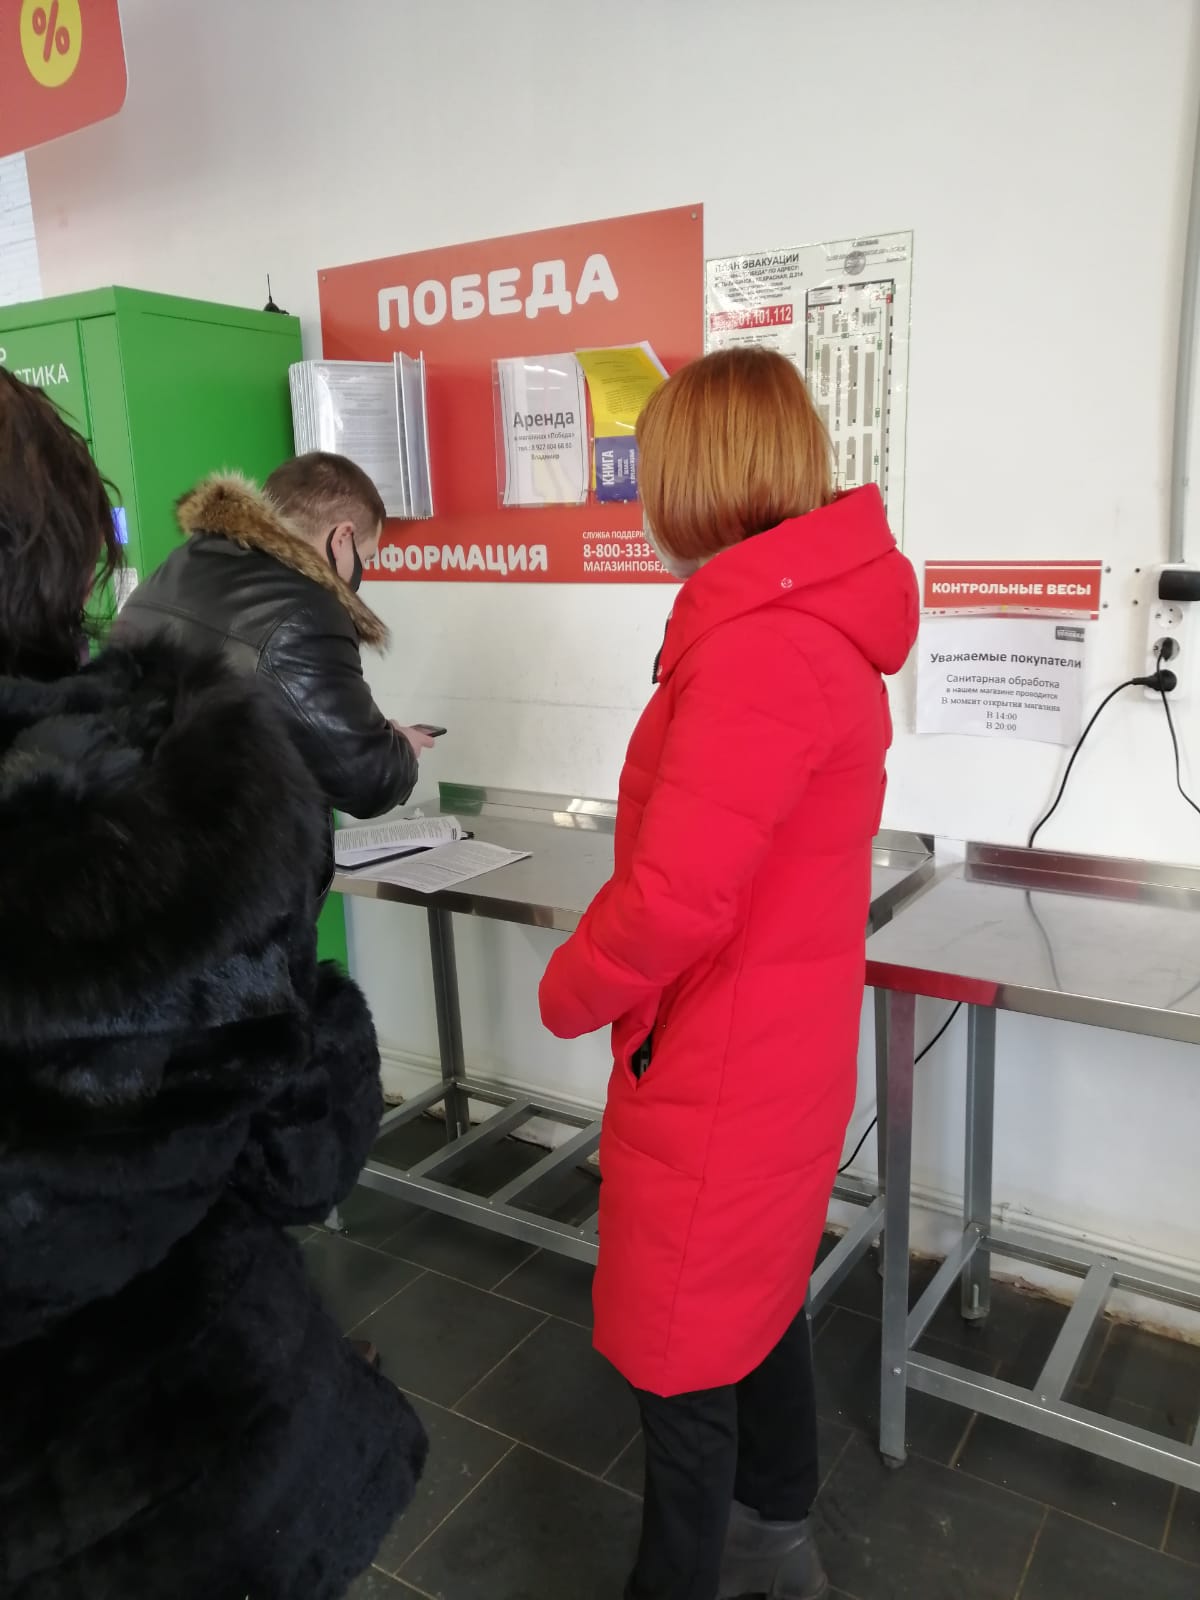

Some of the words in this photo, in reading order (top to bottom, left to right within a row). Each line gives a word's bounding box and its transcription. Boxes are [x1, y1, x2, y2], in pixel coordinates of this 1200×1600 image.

[742, 253, 799, 269] ЭВАКУАЦИИ
[377, 253, 619, 332] ПОБЕДА
[513, 411, 575, 431] Аренда
[601, 450, 615, 485] КНИГА
[582, 531, 611, 539] СЛУЖБА
[364, 543, 548, 576] НФОРМАЦИЯ
[931, 582, 1043, 595] КОНТРОЛЬНЫЕ
[1046, 583, 1092, 596] ВЕСЫ
[930, 652, 1007, 664] Уважаемые
[1010, 653, 1082, 669] покупатели
[946, 674, 1006, 685] Санитарная
[1008, 676, 1060, 689] обработка
[996, 711, 1018, 721] 14:00
[994, 722, 1017, 731] 20:00
